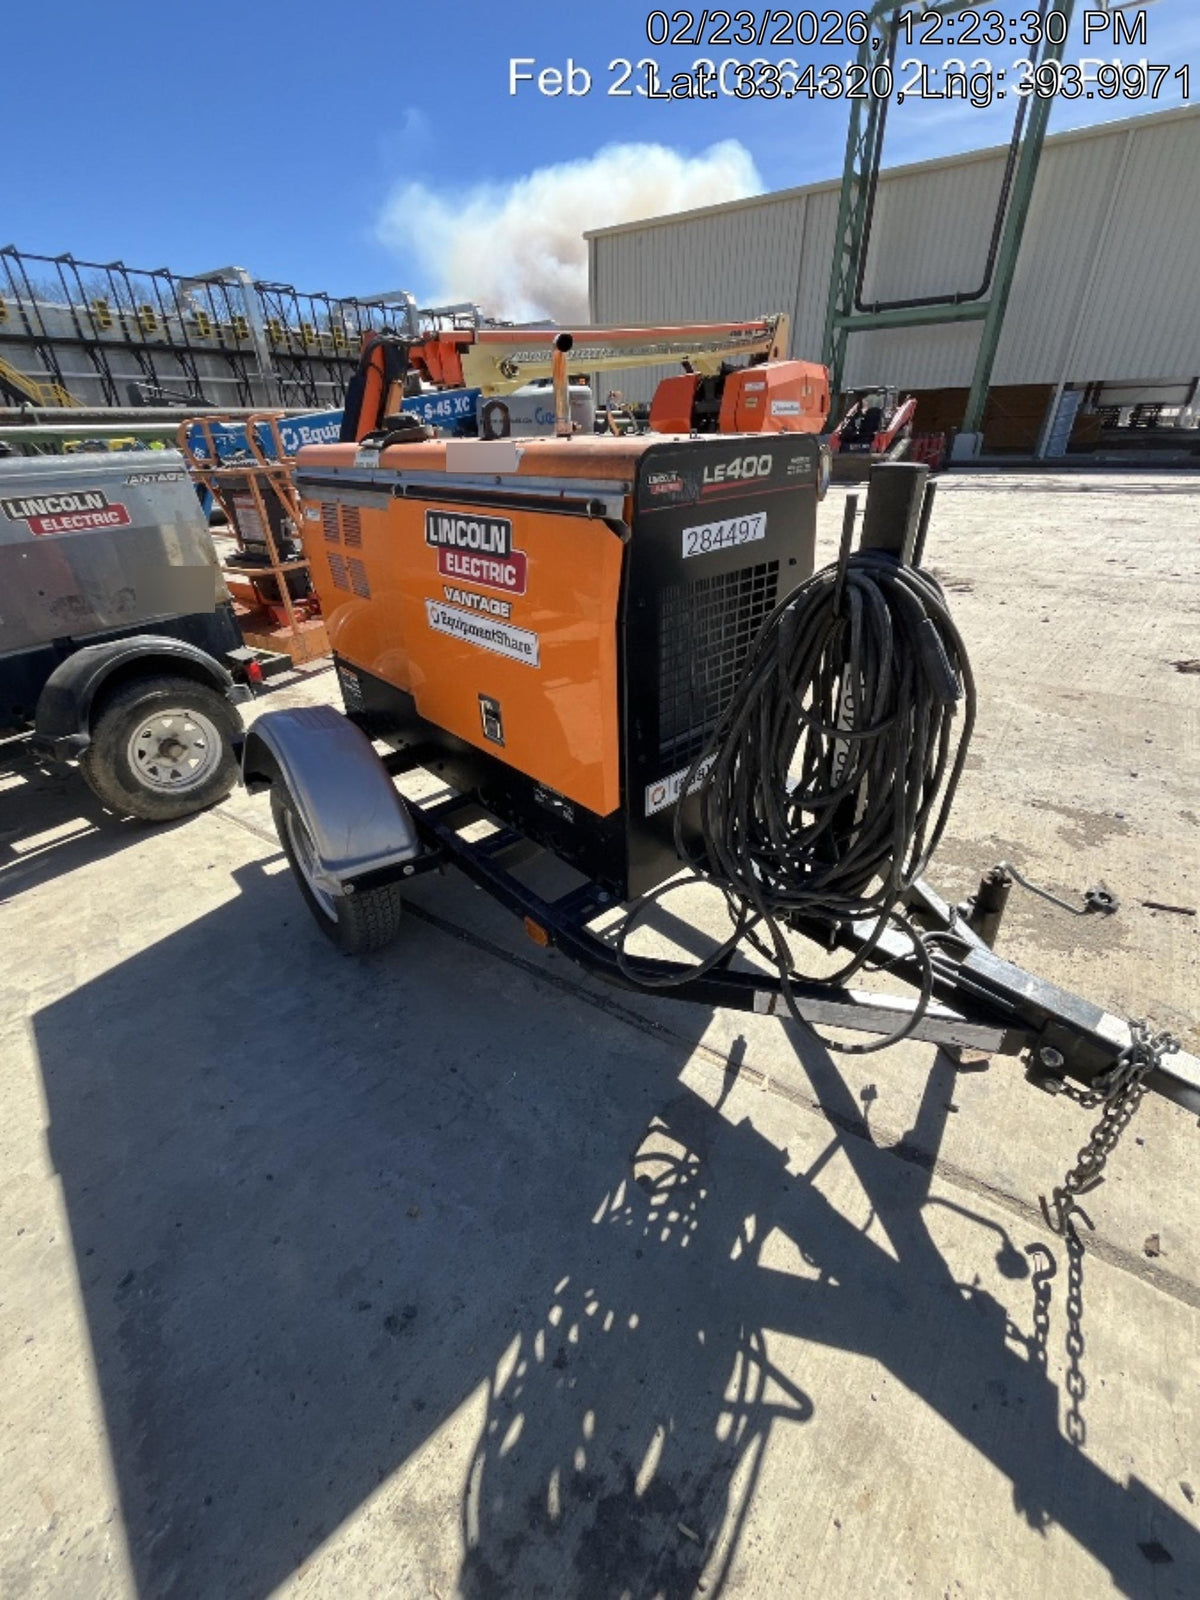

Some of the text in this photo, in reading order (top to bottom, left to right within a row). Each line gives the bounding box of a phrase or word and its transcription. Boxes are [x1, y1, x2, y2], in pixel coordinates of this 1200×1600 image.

[703, 454, 772, 483] LE400
[7, 494, 104, 518] LINCOLN
[40, 511, 120, 531] ELECTRIC
[429, 517, 506, 554] LINCOLN
[687, 517, 762, 551] 284497
[445, 552, 517, 586] ELECTRIC
[443, 586, 511, 618] VANTAGE
[440, 611, 533, 655] EquipmentShare
